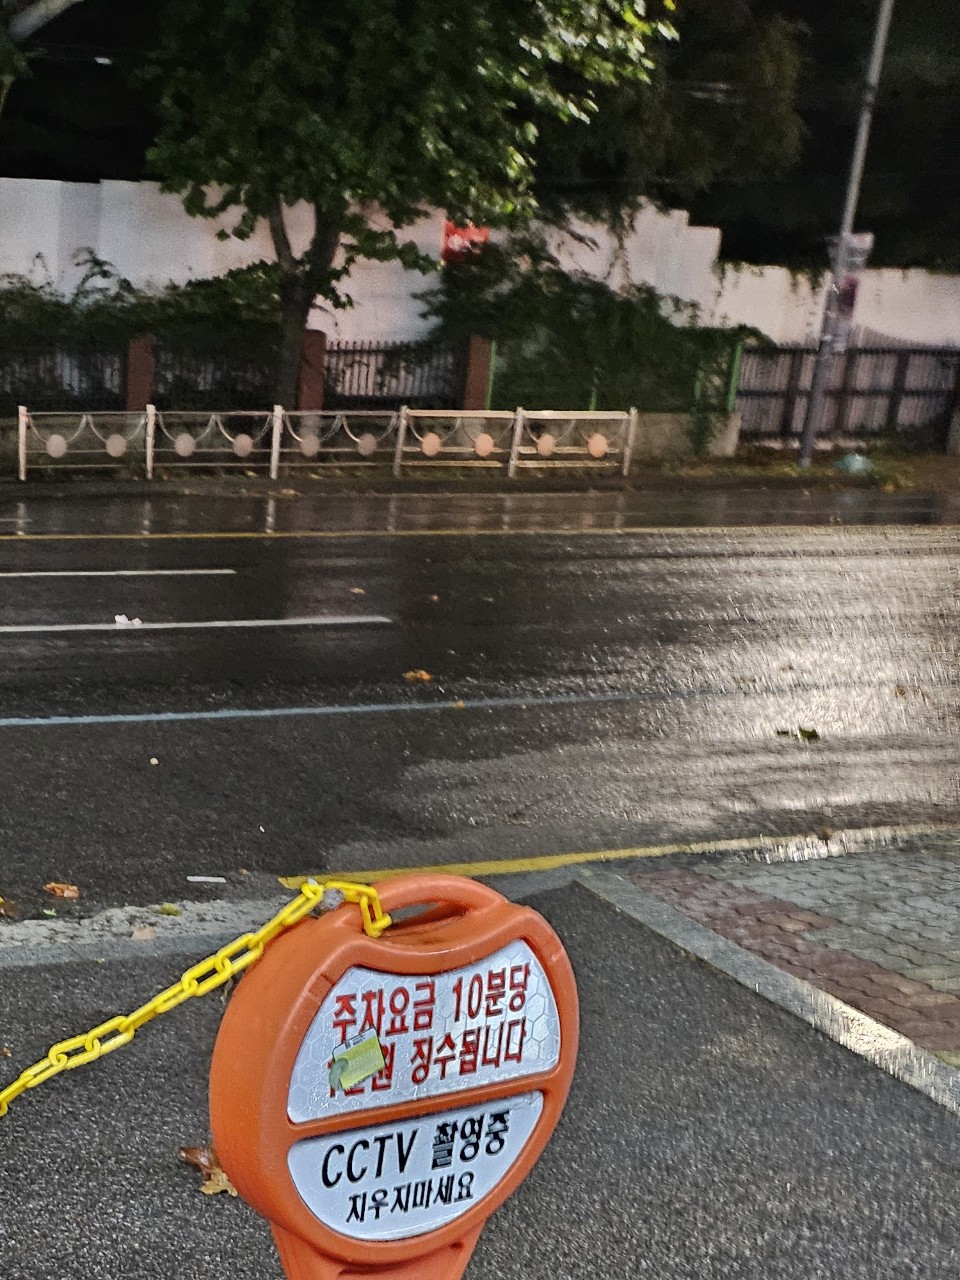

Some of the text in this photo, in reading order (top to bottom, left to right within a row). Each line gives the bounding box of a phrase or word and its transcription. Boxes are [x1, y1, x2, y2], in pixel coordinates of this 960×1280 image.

[332, 962, 531, 1044] 주차요금 10분당
[411, 1017, 527, 1085] 징수됩니다
[321, 1110, 511, 1188] CCTV 촬영중
